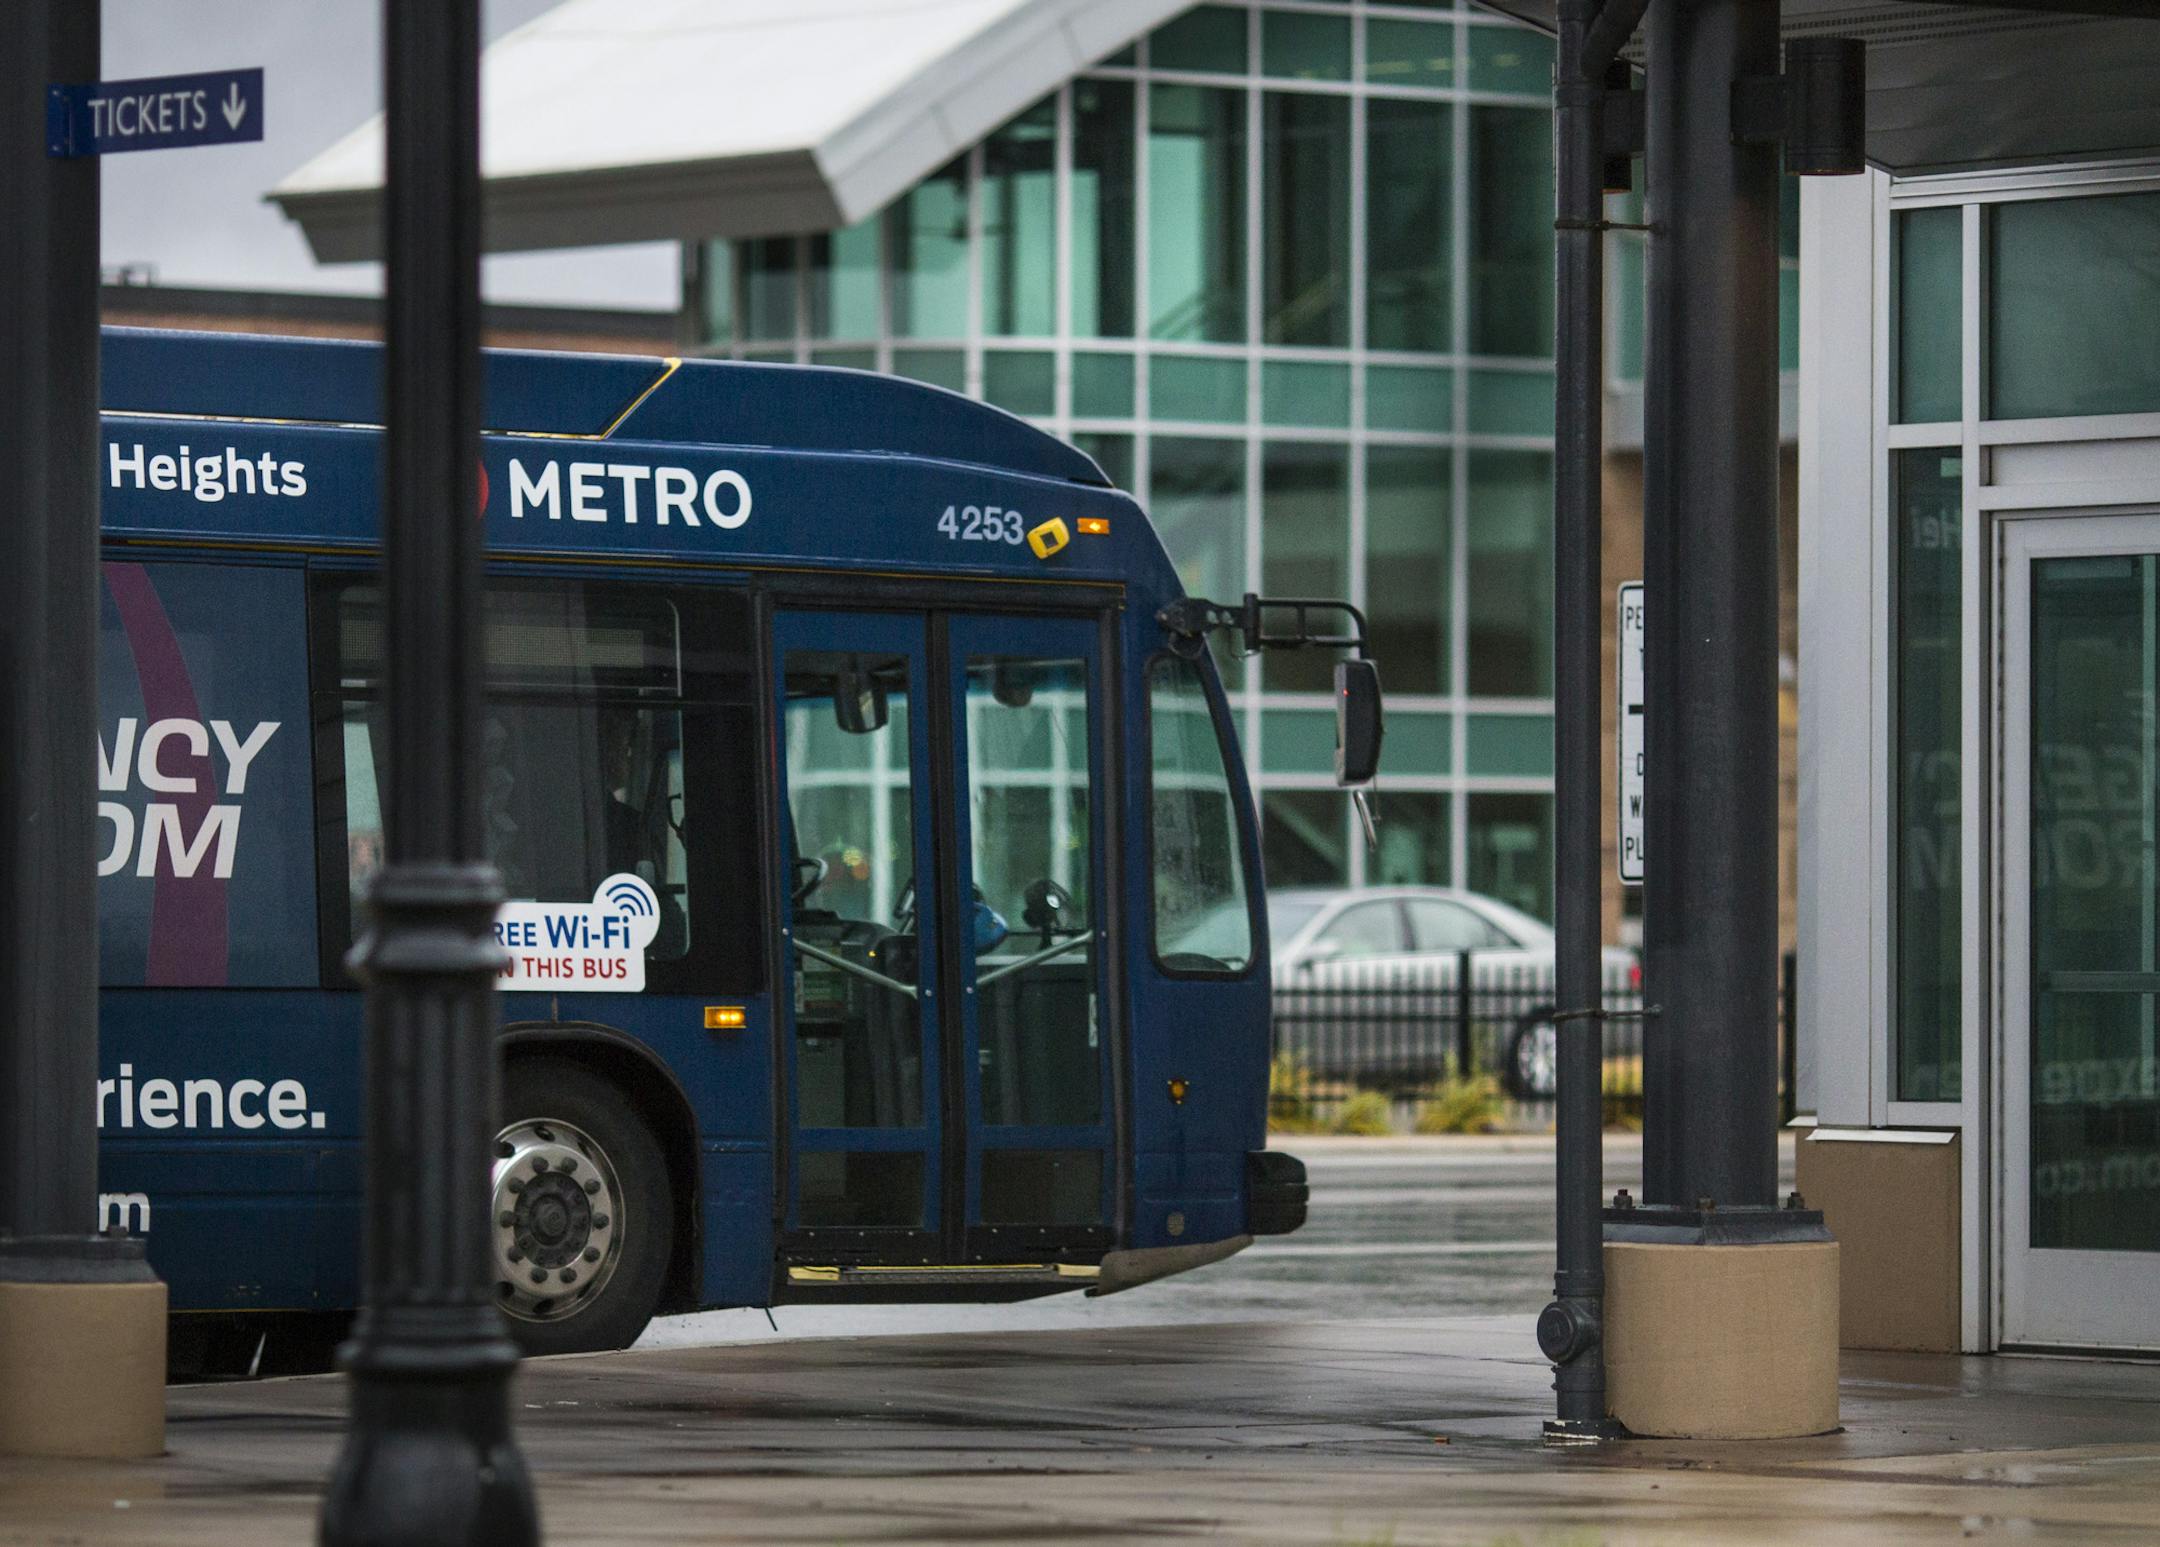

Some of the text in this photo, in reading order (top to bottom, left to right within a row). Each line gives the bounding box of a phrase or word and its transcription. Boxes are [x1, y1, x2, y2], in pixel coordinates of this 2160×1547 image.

[88, 90, 206, 138] TICKETS
[108, 442, 308, 502] Heights
[508, 458, 753, 529] METRO
[937, 505, 1025, 545] 4253
[544, 914, 630, 949] Wi-Fi
[522, 957, 574, 978] THIS
[583, 958, 627, 979] BUS
[96, 1063, 326, 1129] rience.
